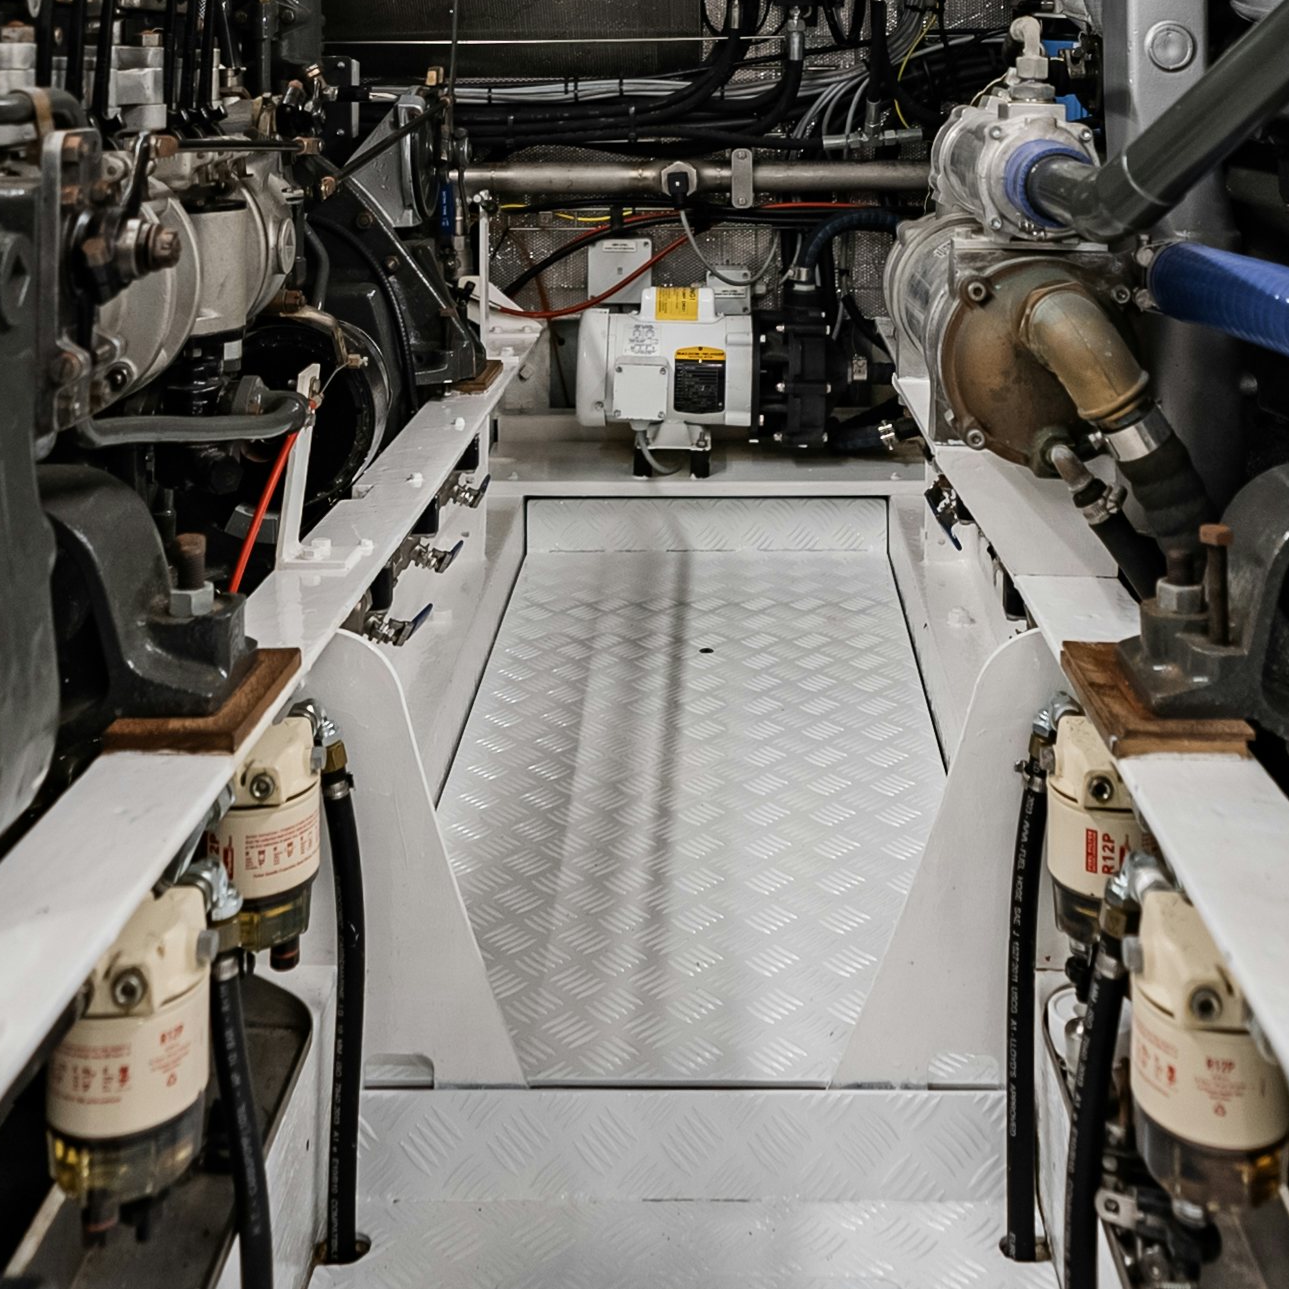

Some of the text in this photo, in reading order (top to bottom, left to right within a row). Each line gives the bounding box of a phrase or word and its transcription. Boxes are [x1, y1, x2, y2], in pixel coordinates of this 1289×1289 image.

[1101, 833, 1116, 875] R12P
[1014, 875, 1023, 902] HOSE
[1013, 907, 1021, 924] SAE
[1009, 1082, 1017, 1137] APPROVED
